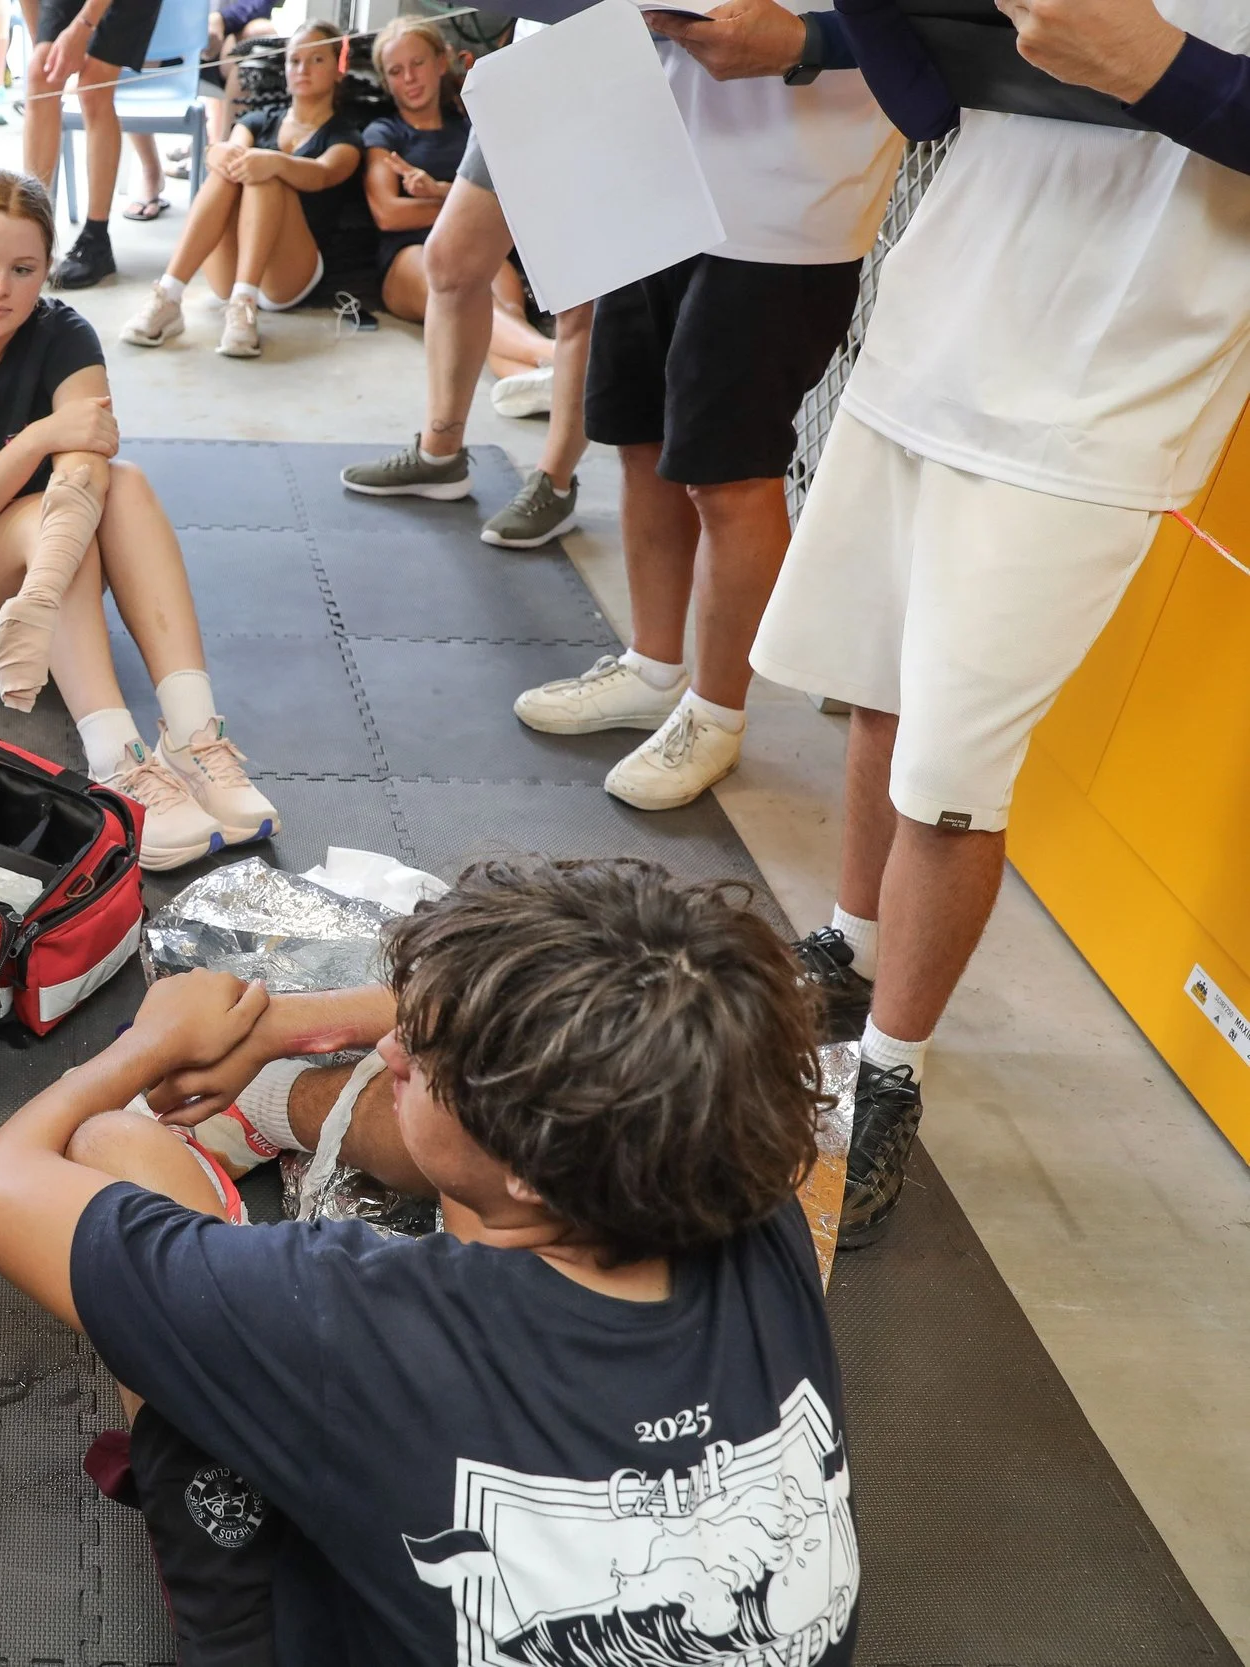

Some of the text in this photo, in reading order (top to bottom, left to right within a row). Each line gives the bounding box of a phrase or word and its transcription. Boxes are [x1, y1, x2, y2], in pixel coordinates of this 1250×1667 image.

[249, 1131, 278, 1155] NIKE
[634, 1402, 713, 1443] 2025
[203, 1467, 231, 1482] CLUB
[608, 1439, 736, 1519] CAMP
[190, 1494, 206, 1519] SURF
[218, 1525, 255, 1540] HEADS
